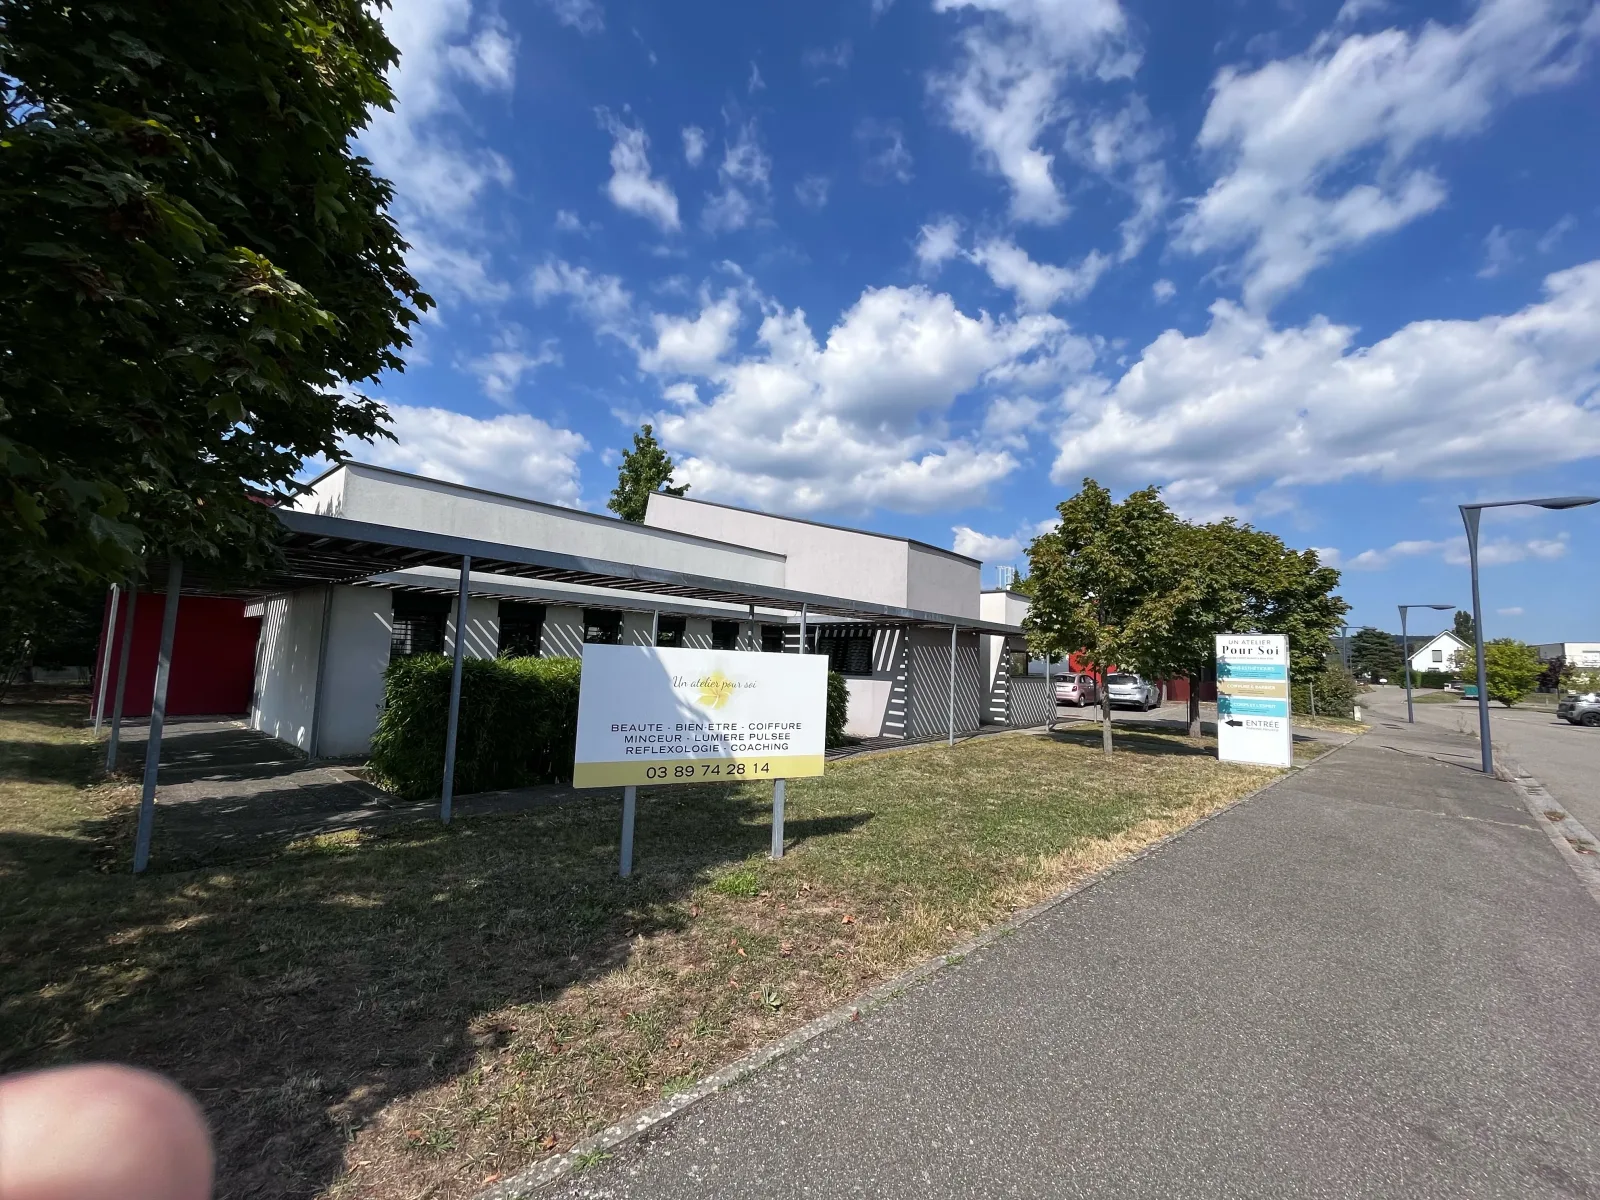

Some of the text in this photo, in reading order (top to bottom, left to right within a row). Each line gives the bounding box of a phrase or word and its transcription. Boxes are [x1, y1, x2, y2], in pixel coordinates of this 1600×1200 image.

[1222, 645, 1279, 655] Pour Soi
[673, 675, 757, 691] Un atelier pour soi
[611, 723, 663, 732] BEAUTE
[675, 723, 737, 731] BIEN-ETRE
[748, 722, 802, 730] COIFFURE
[1246, 719, 1280, 728] ENTRÉE
[624, 735, 682, 743] MINCEUR
[694, 733, 745, 742] LUMIERE
[749, 733, 791, 741] PULSEE
[625, 744, 720, 755] REFLEXOLOGIE
[730, 743, 789, 752] COACHING
[646, 762, 770, 779] 03 89 74 28 14
